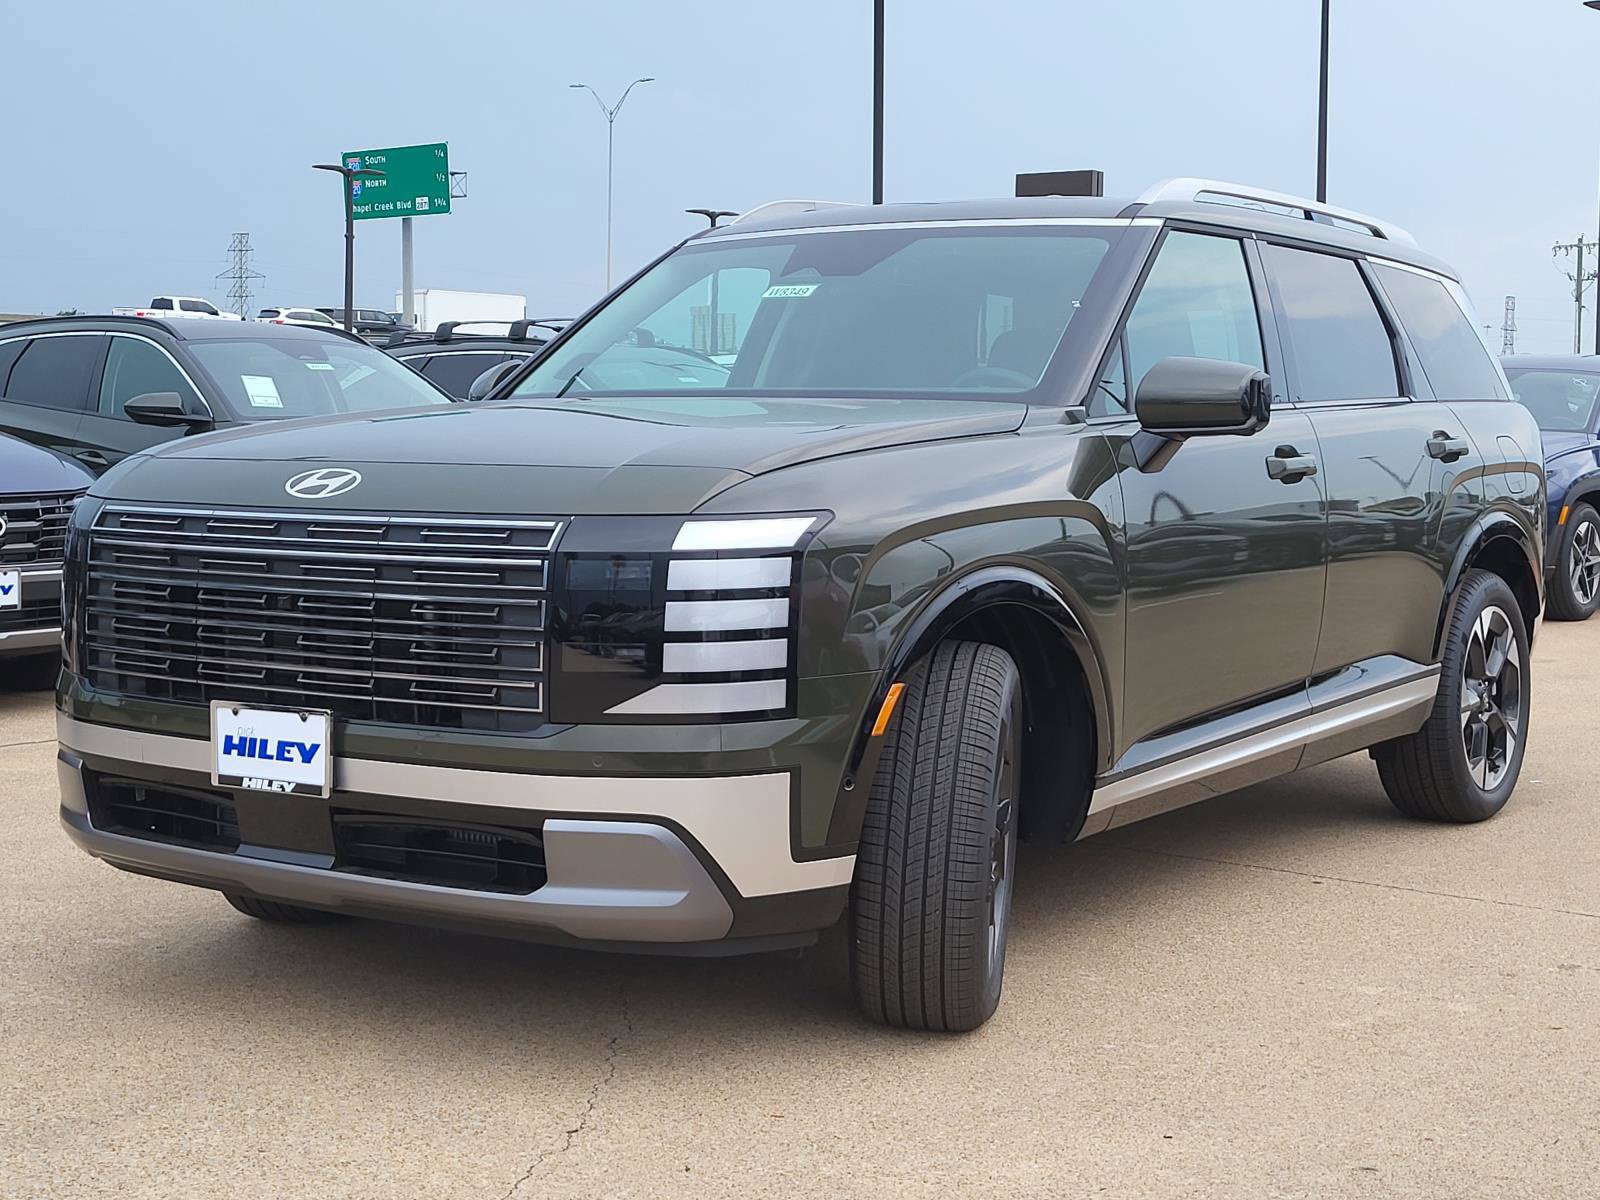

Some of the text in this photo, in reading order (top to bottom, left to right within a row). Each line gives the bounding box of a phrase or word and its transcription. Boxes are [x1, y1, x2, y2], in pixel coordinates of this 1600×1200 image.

[365, 156, 386, 165] SOUTH
[365, 179, 387, 188] NORTH
[352, 204, 372, 214] hapel
[374, 202, 394, 211] Creek
[396, 200, 412, 209] Blvd
[223, 735, 321, 764] HILEY
[242, 777, 297, 793] HILEY
